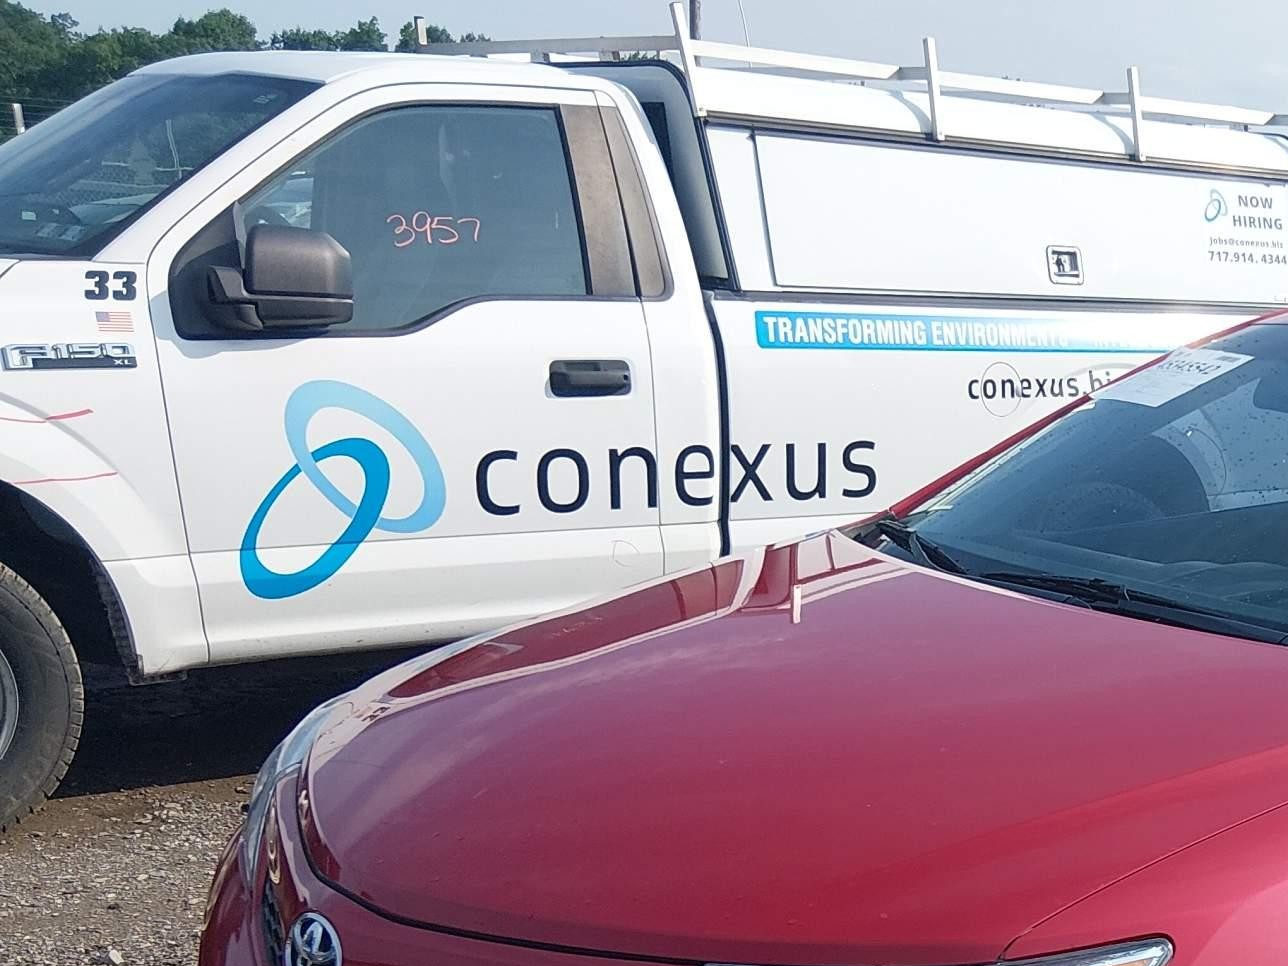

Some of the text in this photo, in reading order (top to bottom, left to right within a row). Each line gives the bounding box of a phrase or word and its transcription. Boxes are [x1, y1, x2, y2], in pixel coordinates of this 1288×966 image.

[1237, 195, 1273, 209] NOW
[386, 211, 480, 247] 3957
[1232, 215, 1283, 230] HIRING
[1208, 251, 1287, 265] 717.914.4344
[84, 270, 137, 301] 33
[763, 315, 928, 346] TRANSFORMING
[475, 439, 877, 516] conexus
